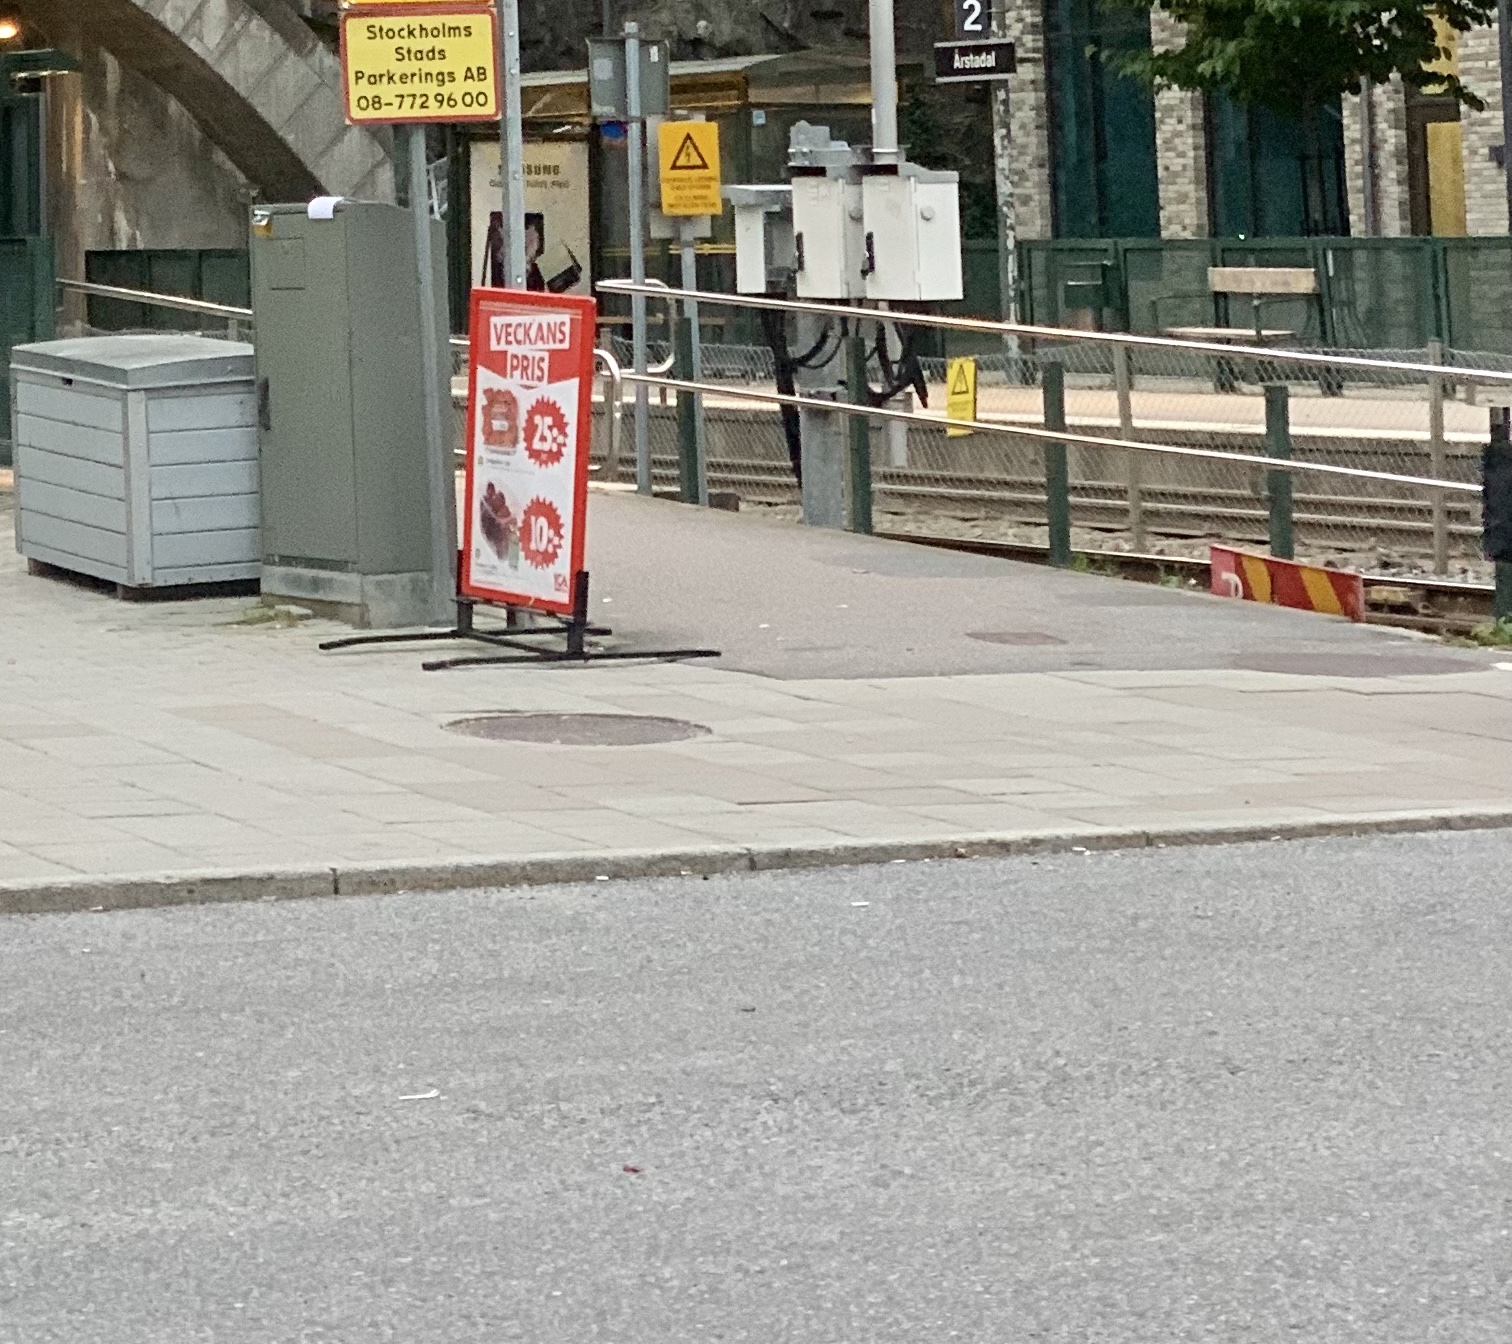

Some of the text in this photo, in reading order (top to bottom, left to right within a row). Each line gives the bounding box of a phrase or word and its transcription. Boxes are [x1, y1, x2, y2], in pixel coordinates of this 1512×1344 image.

[366, 23, 472, 40] Stockholms
[394, 46, 447, 62] Stads
[953, 48, 996, 70] Årstadal
[354, 66, 488, 87] Parkerings AB
[493, 320, 567, 346] VECKANS
[509, 354, 546, 383] PRIS
